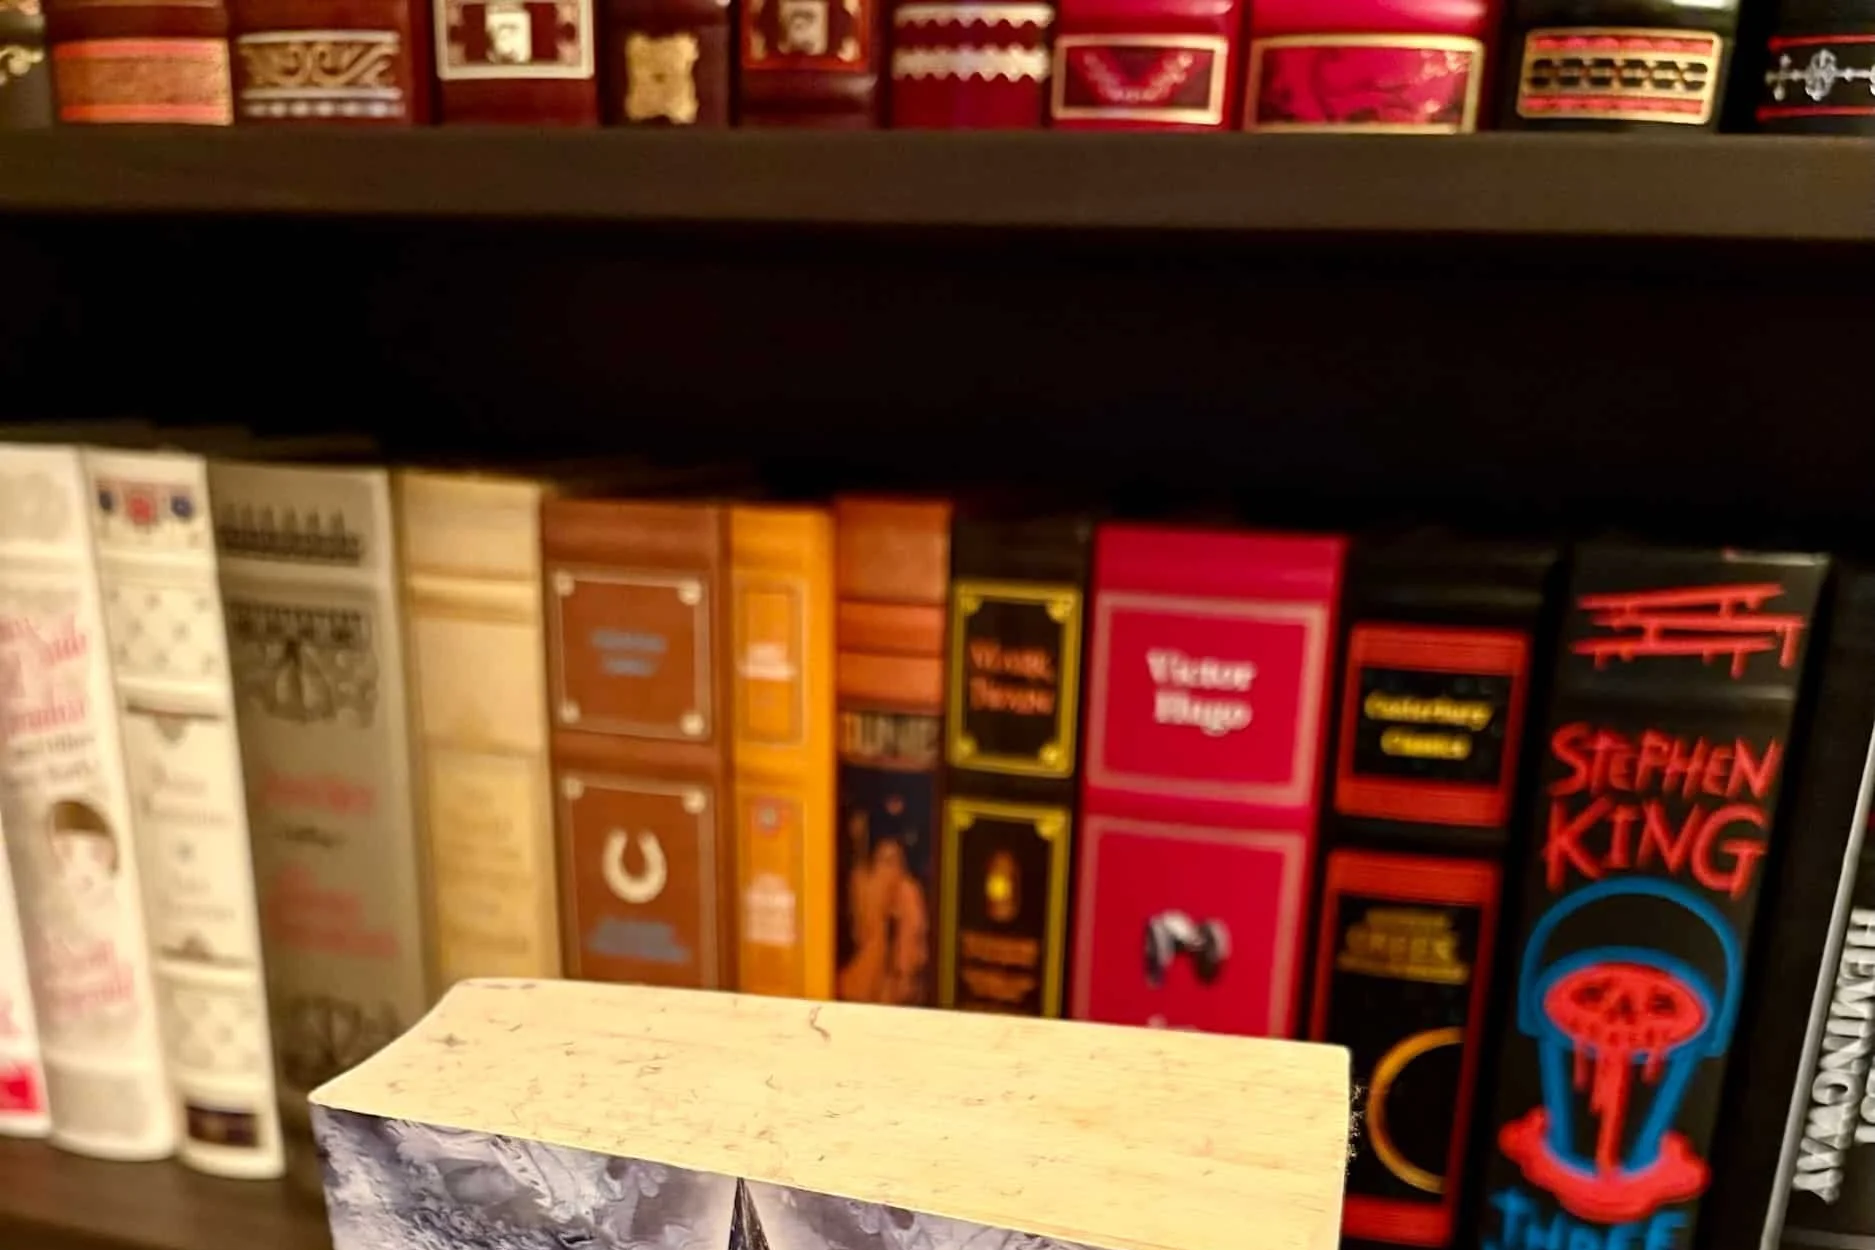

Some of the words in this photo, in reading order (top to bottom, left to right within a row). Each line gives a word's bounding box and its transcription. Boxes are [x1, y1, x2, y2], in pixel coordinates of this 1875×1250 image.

[1146, 647, 1257, 692] Victor
[1155, 688, 1253, 737] Hugo
[1548, 722, 1782, 798] STEPHEN
[1545, 798, 1766, 900] KING
